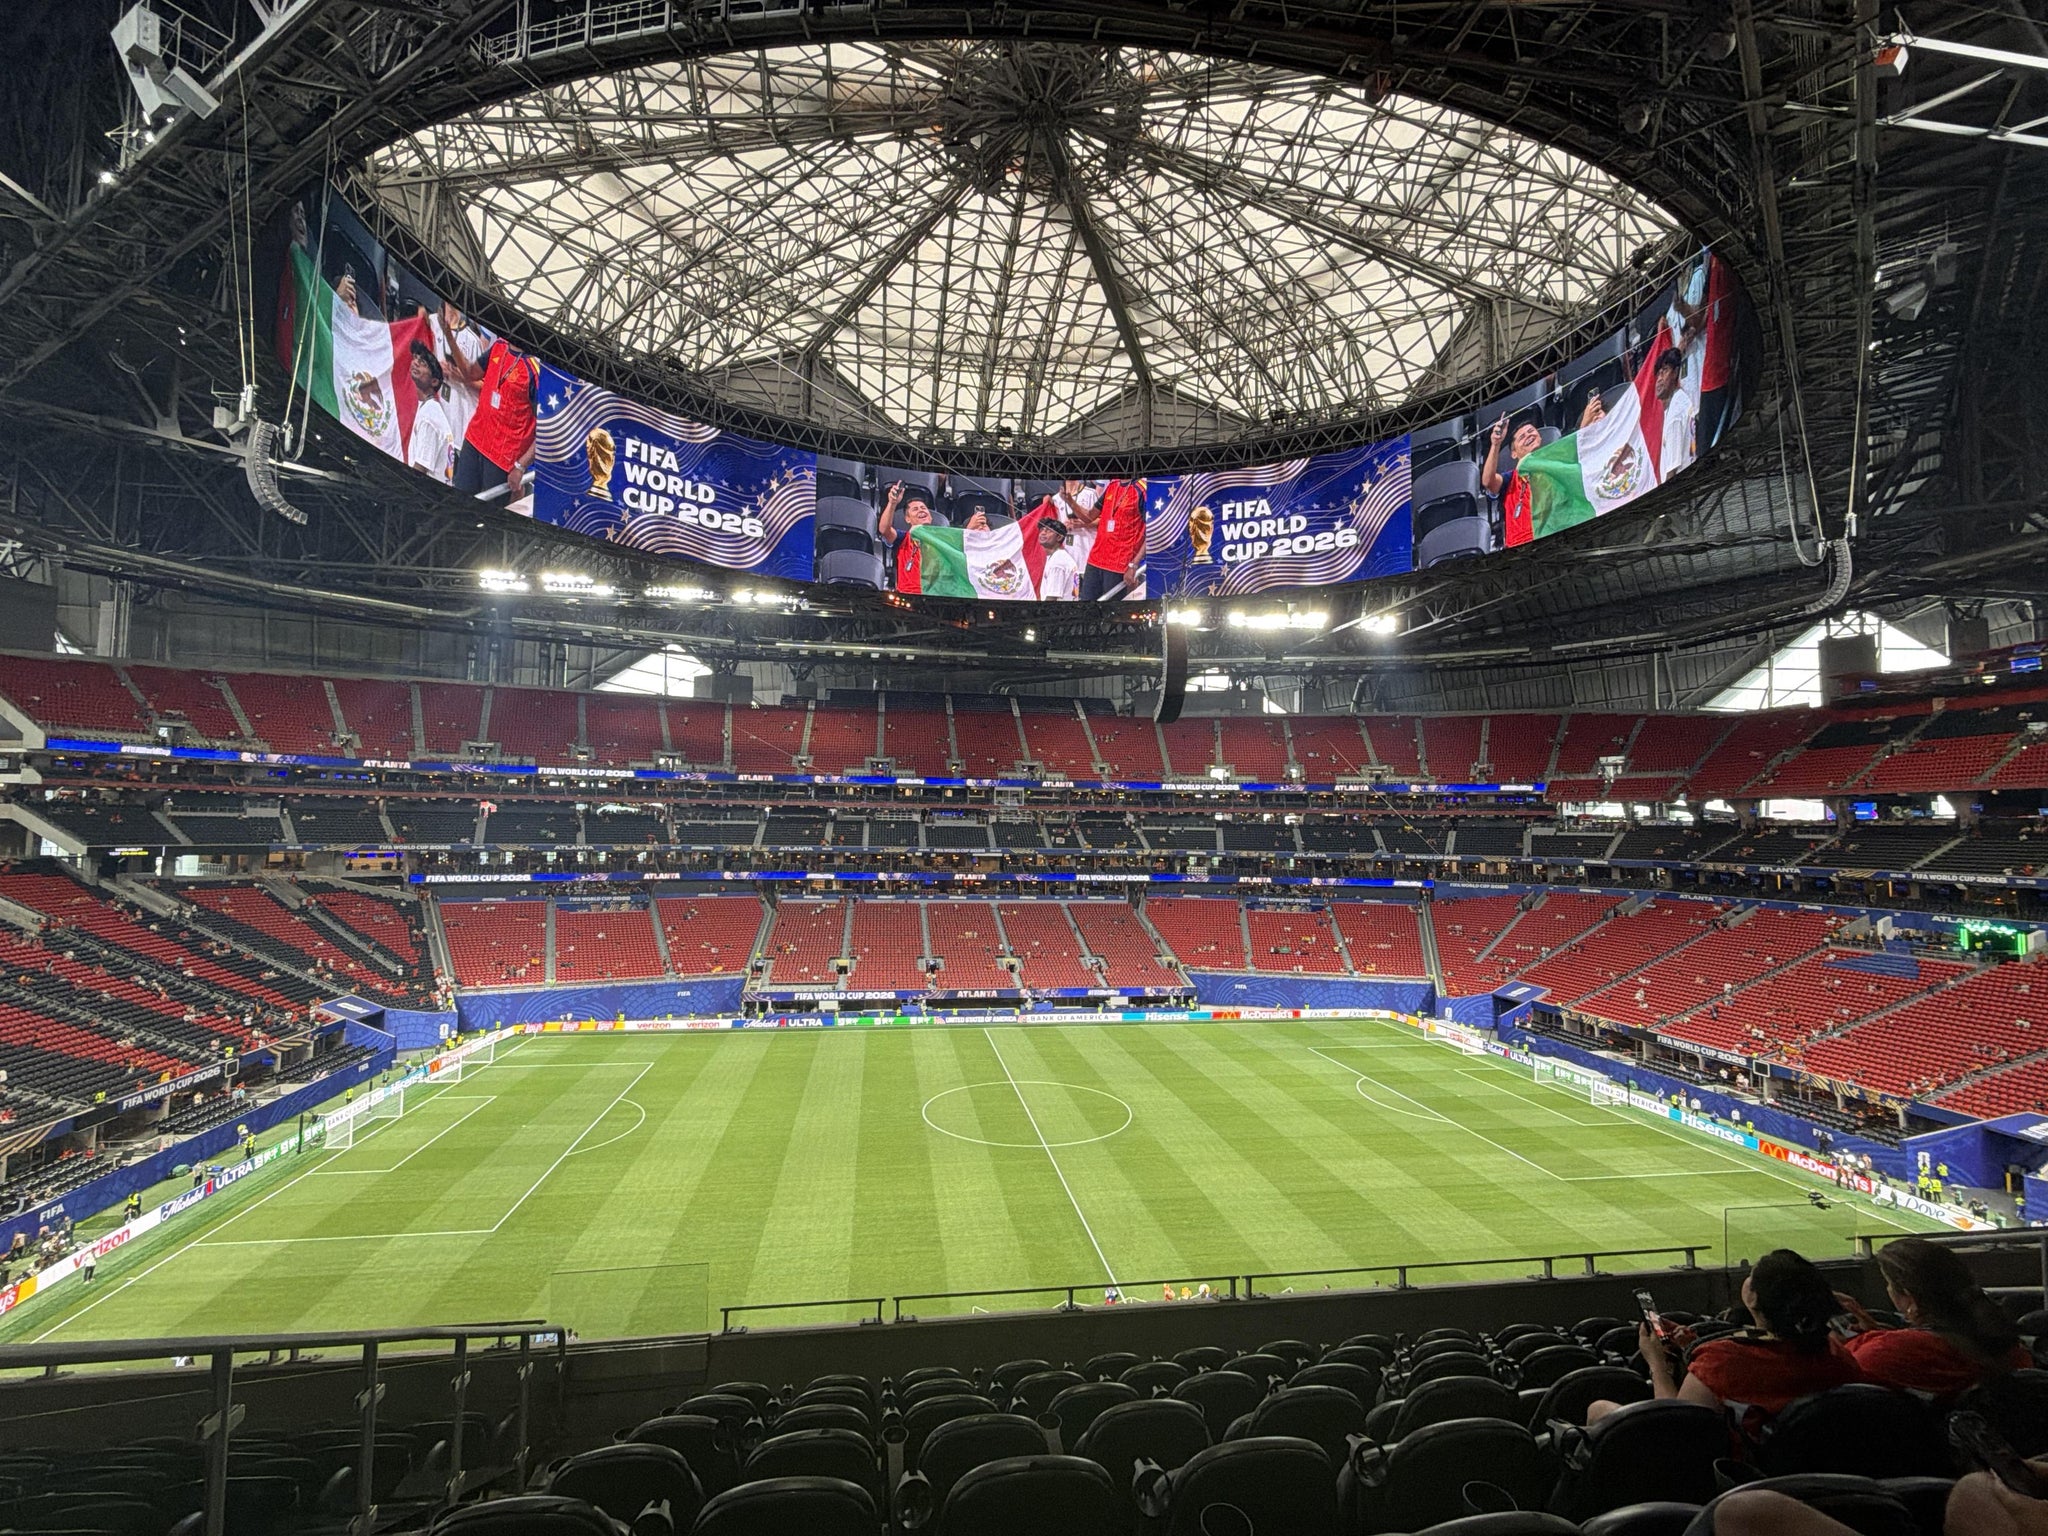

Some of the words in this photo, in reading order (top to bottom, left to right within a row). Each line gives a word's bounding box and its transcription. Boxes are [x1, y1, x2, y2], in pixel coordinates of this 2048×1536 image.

[625, 438, 679, 472] FIFA
[624, 461, 715, 504] WORLD
[622, 487, 674, 515] CUP
[678, 503, 764, 538] 2026
[1222, 499, 1272, 521] FIFA
[1221, 515, 1307, 541] WORLD
[1221, 541, 1268, 562] CUP
[1272, 528, 1358, 557] 2026
[363, 759, 411, 769] ATLANTA
[559, 768, 588, 776] WORLD
[426, 875, 445, 883] FIFA
[480, 874, 499, 882] CUP
[1680, 894, 1713, 902] ATLANTA
[1931, 914, 1991, 926] ATLANTA
[957, 990, 997, 998] ATLANTA
[789, 1018, 823, 1026] ULTRA
[1145, 1011, 1189, 1020] Hisense
[1510, 1052, 1533, 1067] ULTRA
[1657, 1035, 1674, 1045] FIFA
[1674, 1040, 1700, 1053] WORLD
[1701, 1048, 1716, 1057] CUP
[1716, 1052, 1747, 1066] 2026
[122, 1097, 143, 1110] FIFA
[144, 1083, 175, 1101] WORLD
[176, 1078, 192, 1088] CUP
[193, 1066, 220, 1083] 2026
[1681, 1112, 1744, 1145] Hisense
[216, 1160, 253, 1190] ULTRA
[40, 1203, 65, 1222] FIFA
[1905, 1197, 1945, 1218] Dove
